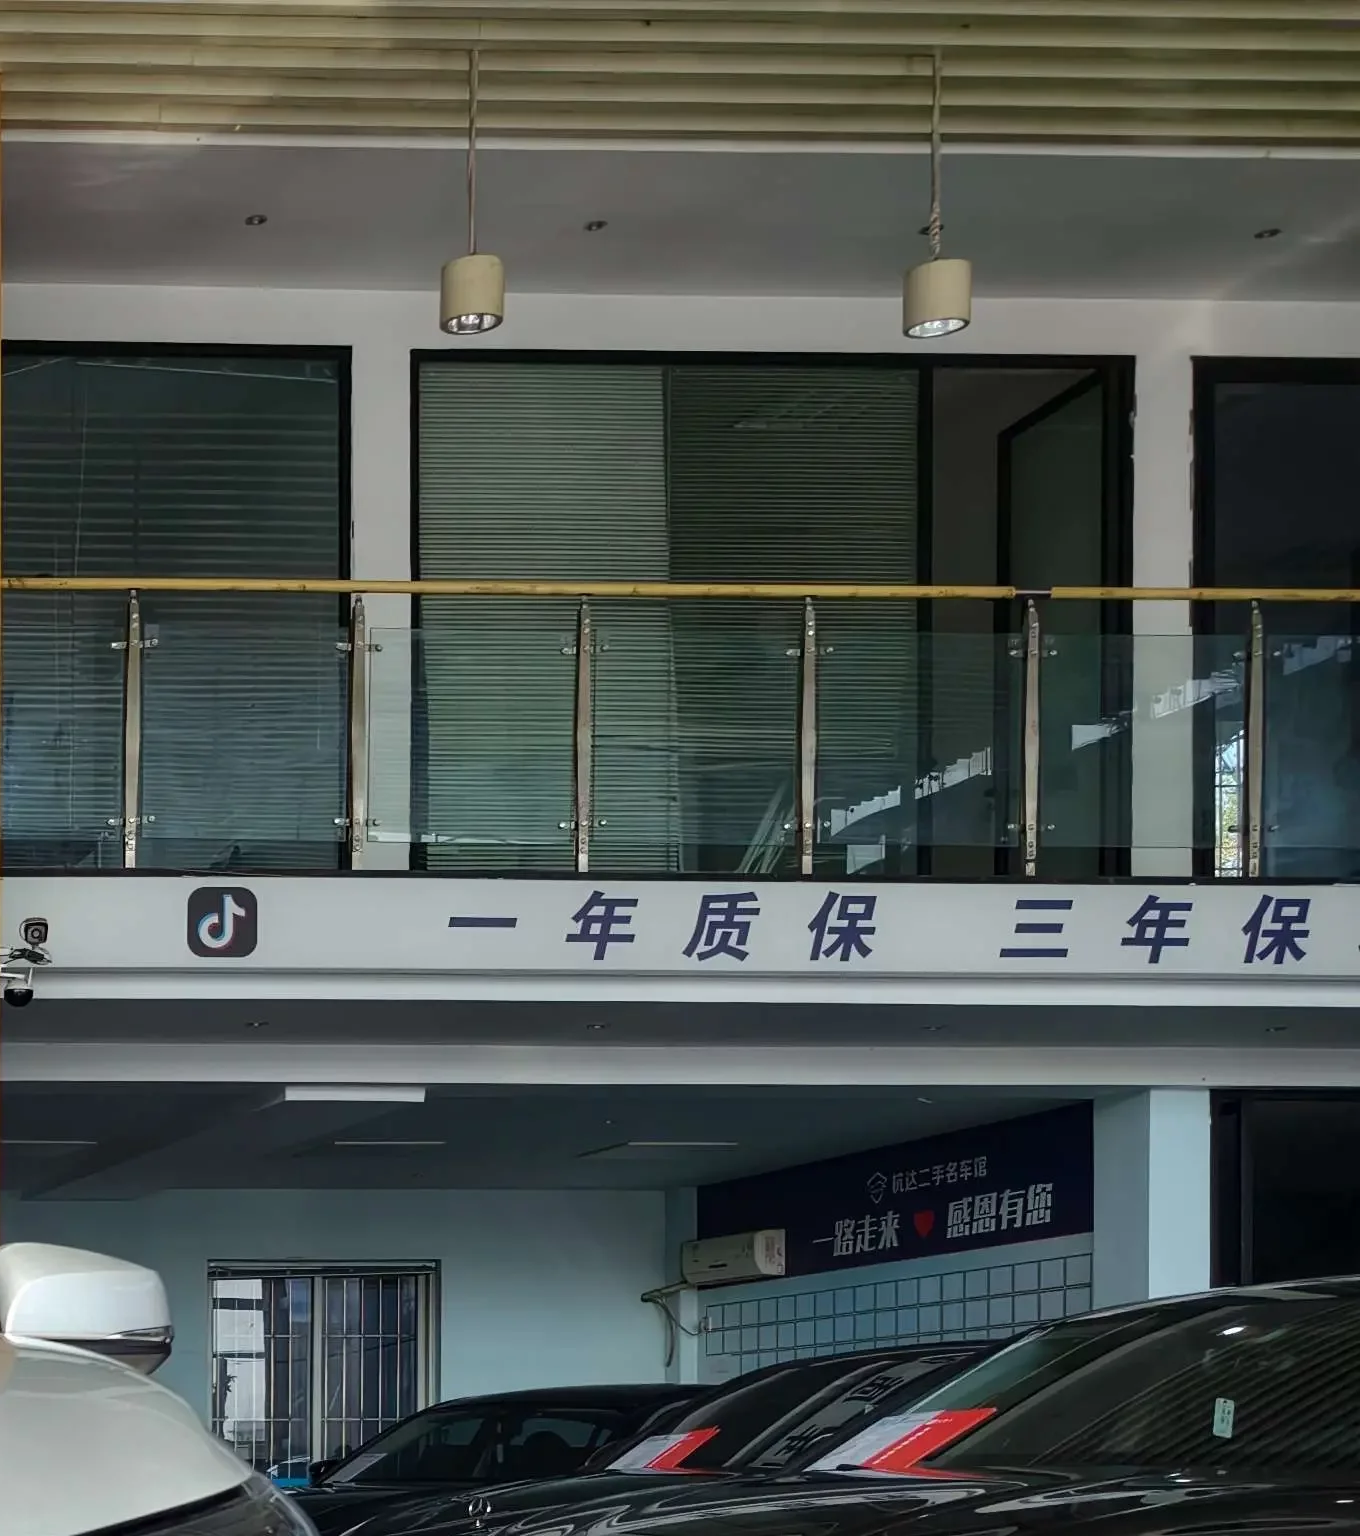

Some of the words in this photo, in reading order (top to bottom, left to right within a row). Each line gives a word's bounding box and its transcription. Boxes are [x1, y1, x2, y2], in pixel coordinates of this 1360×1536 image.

[448, 889, 879, 964] 一年质保
[999, 893, 1360, 966] 三年保
[891, 1155, 988, 1196] 杭达二手名车馆
[812, 1209, 901, 1258] 一路走来
[945, 1182, 1054, 1240] 感恩有您
